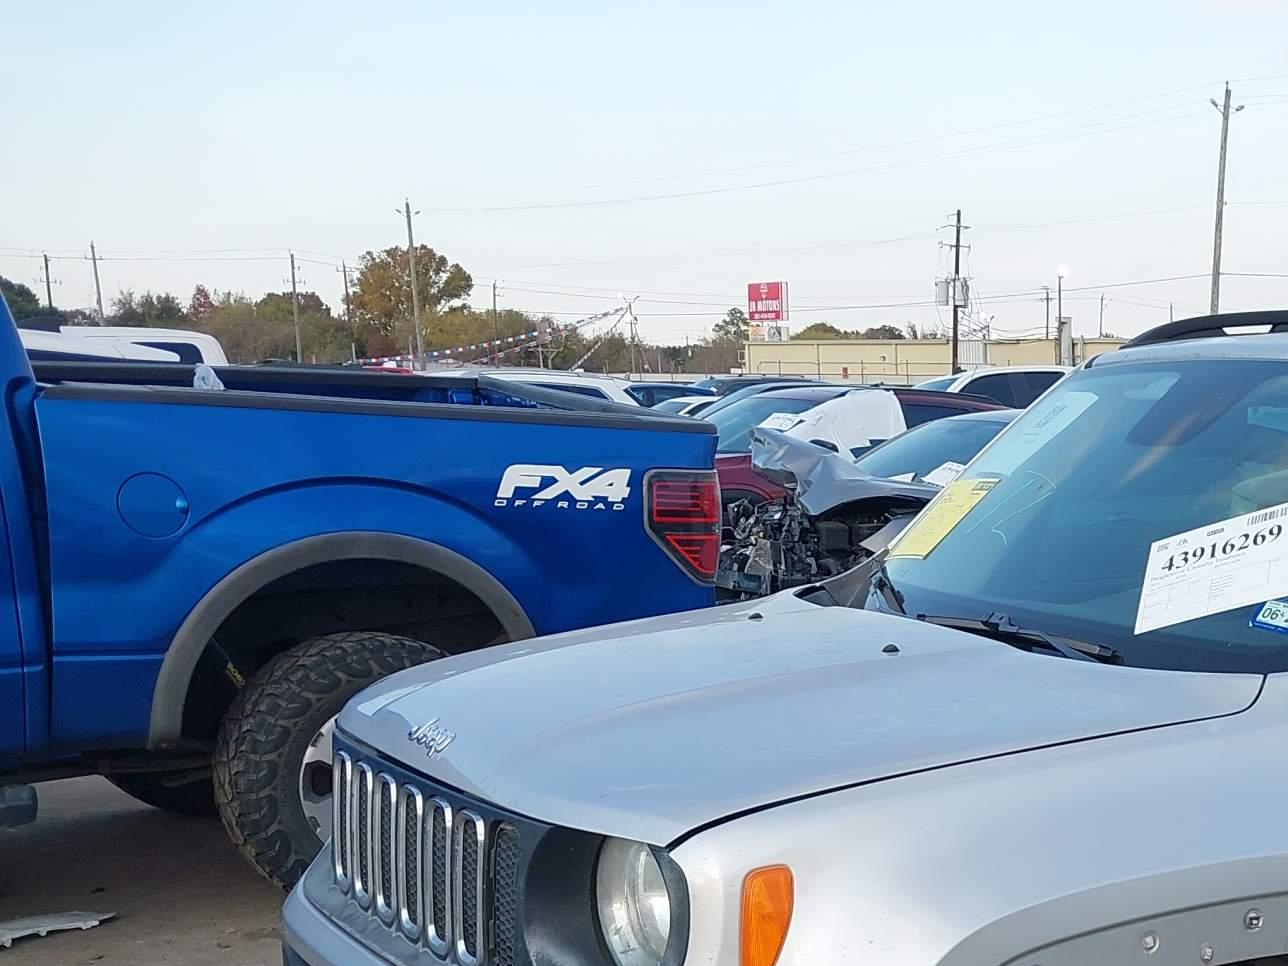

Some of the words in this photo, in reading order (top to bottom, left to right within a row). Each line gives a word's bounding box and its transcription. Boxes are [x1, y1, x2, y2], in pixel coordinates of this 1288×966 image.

[757, 299, 780, 312] MOTORS
[496, 463, 632, 502] FX4
[494, 499, 545, 509] OFF
[557, 501, 625, 511] ROAD
[1161, 523, 1283, 572] 43916269
[1262, 607, 1281, 620] 06
[408, 718, 456, 758] Jeep
